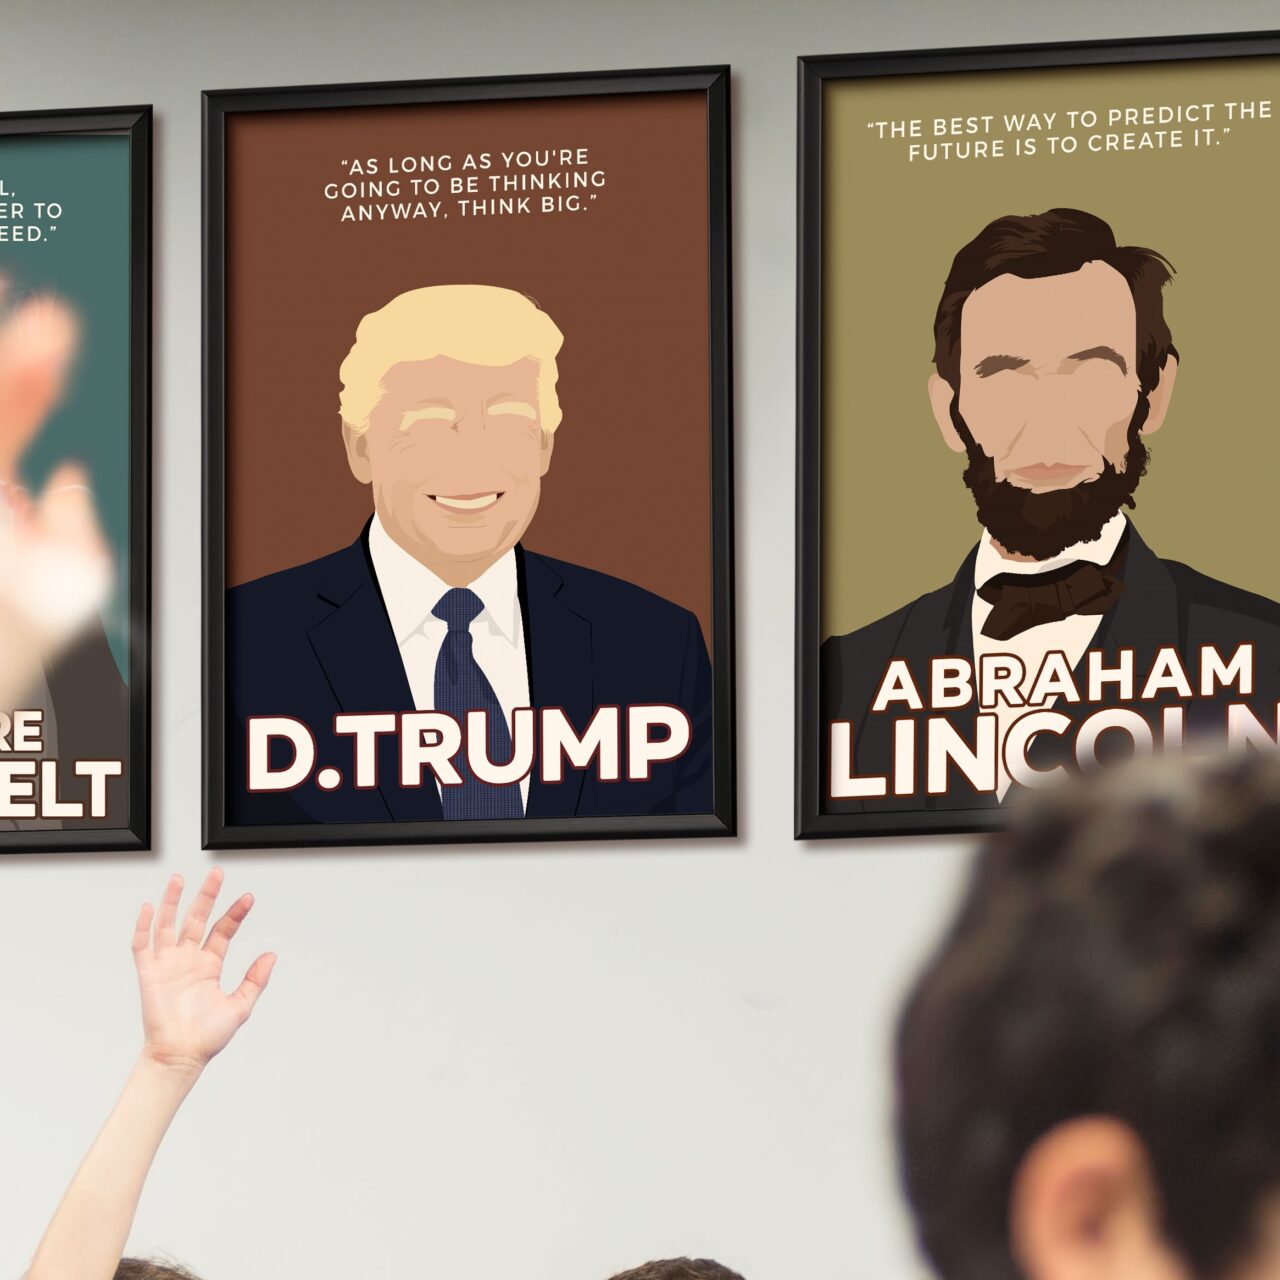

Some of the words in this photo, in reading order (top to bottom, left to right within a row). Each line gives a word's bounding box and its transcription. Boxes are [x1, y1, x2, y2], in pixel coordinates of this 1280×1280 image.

[933, 115, 994, 136] BEST
[1003, 112, 1057, 132] WAY
[1066, 110, 1097, 129] TO
[1108, 103, 1215, 127] PREDICT
[1224, 100, 1272, 120] THE
[389, 154, 452, 174] LONG
[462, 152, 492, 170] AS
[501, 148, 588, 168] YOU'RE
[909, 139, 1004, 162] FUTURE
[1016, 138, 1037, 156] IS
[1046, 135, 1078, 154] TO
[1087, 130, 1183, 152] CREATE
[324, 180, 400, 200] GOING
[410, 178, 440, 196] TO
[450, 176, 479, 194] BE
[488, 170, 605, 192] THINKING
[33, 202, 63, 219] TO
[340, 201, 448, 222] ANYWAY,
[457, 197, 531, 217] THINK
[871, 643, 1255, 712] ABRAHAM
[246, 704, 693, 792] D.TRUMP
